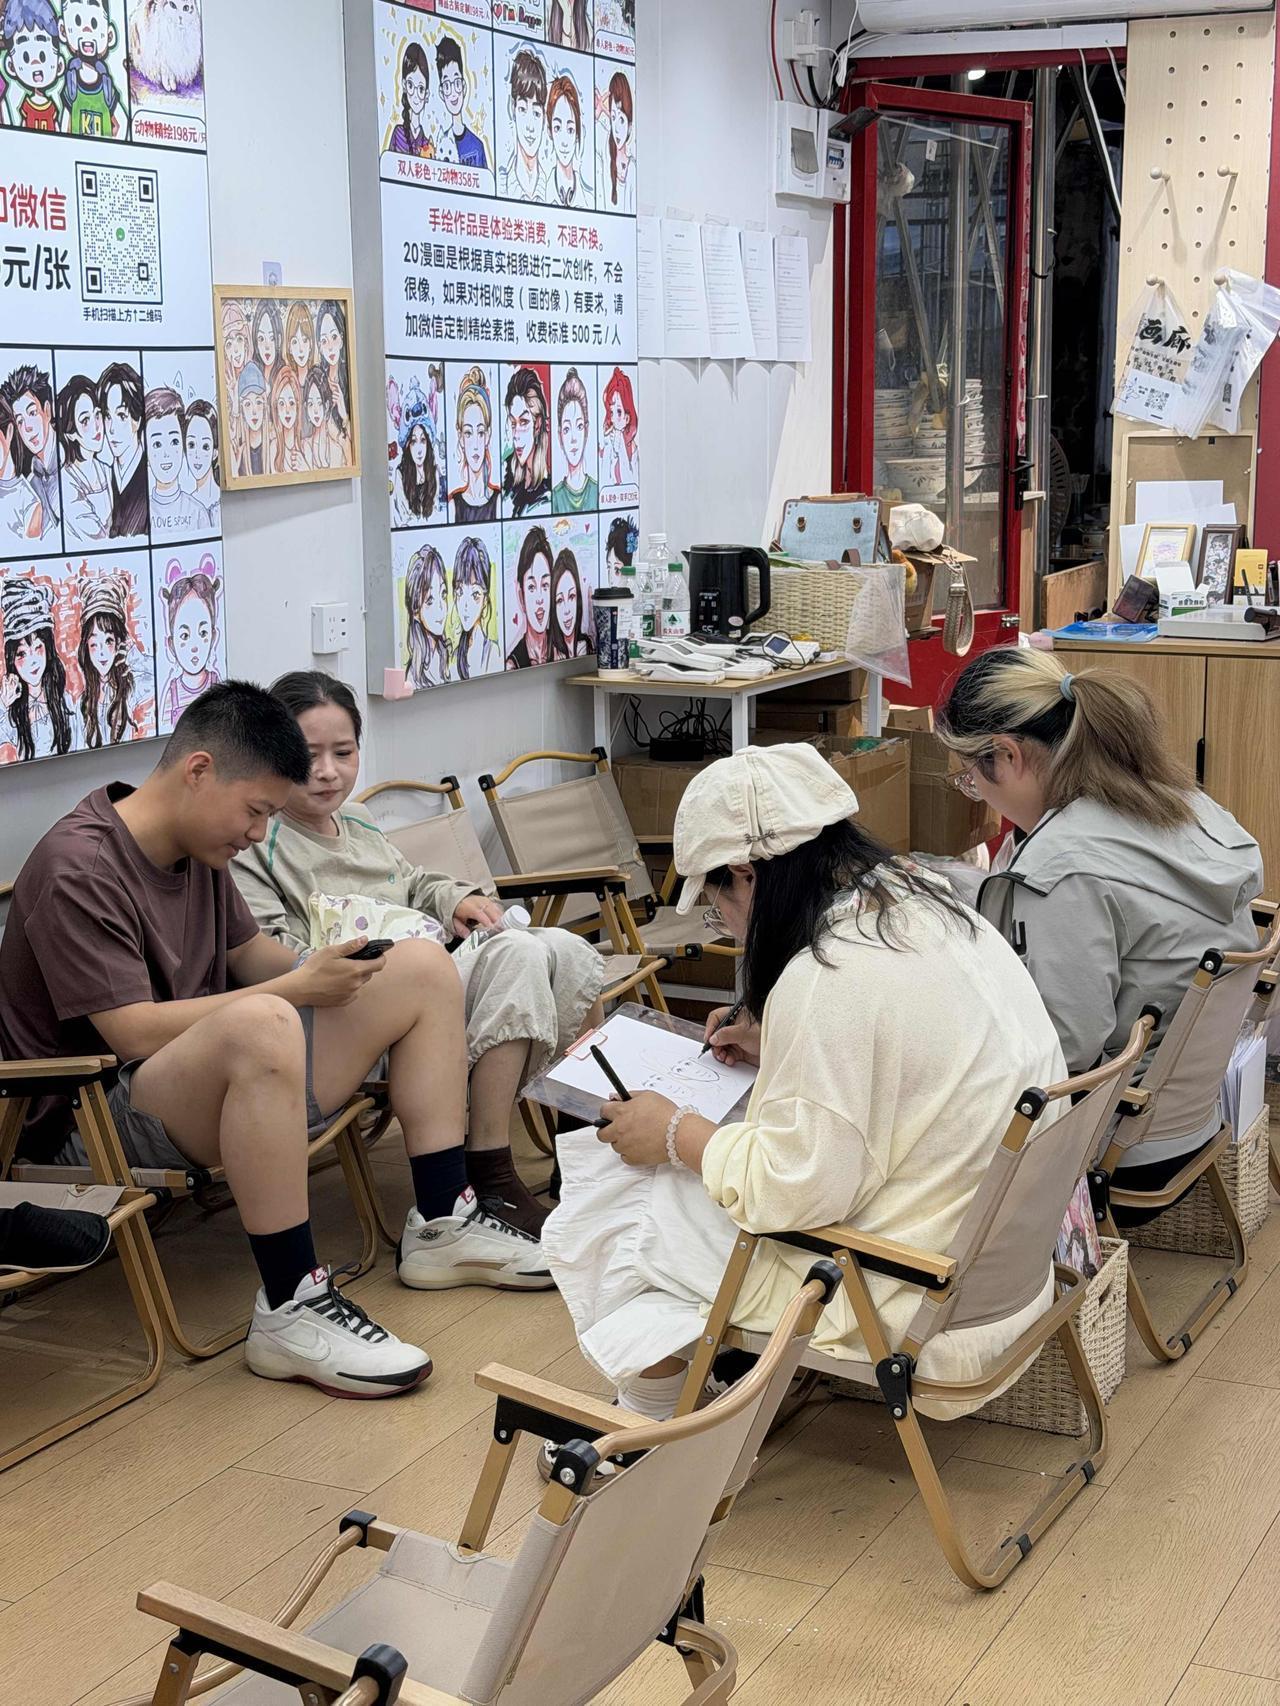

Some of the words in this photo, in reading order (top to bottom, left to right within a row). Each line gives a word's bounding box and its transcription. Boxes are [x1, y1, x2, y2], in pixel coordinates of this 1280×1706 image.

[397, 159, 481, 189] 双人彩色+2动物358元
[428, 207, 603, 252] 手绘作品是体验类消费，不退不换。
[403, 242, 623, 284] 20漫画是根据真实相貌进行二次创作，不会
